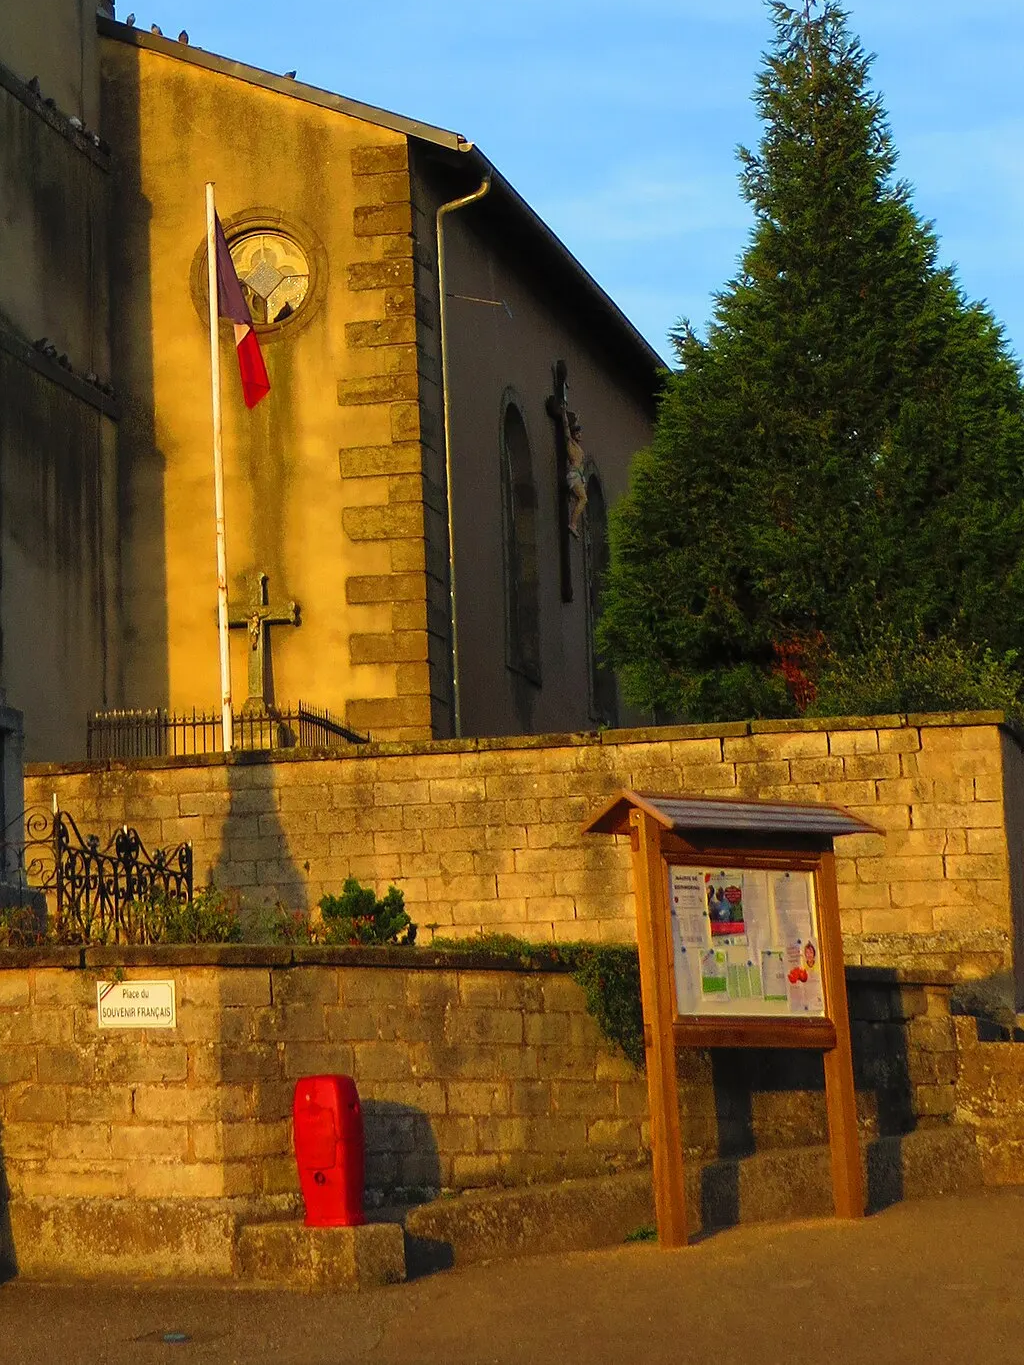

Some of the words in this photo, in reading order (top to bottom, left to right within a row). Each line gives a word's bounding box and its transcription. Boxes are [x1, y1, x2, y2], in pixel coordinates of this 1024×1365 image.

[122, 989, 140, 999] Place
[141, 989, 149, 999] du
[102, 1007, 136, 1018] SOUVENIR
[137, 1007, 171, 1020] FRANÇAIS
